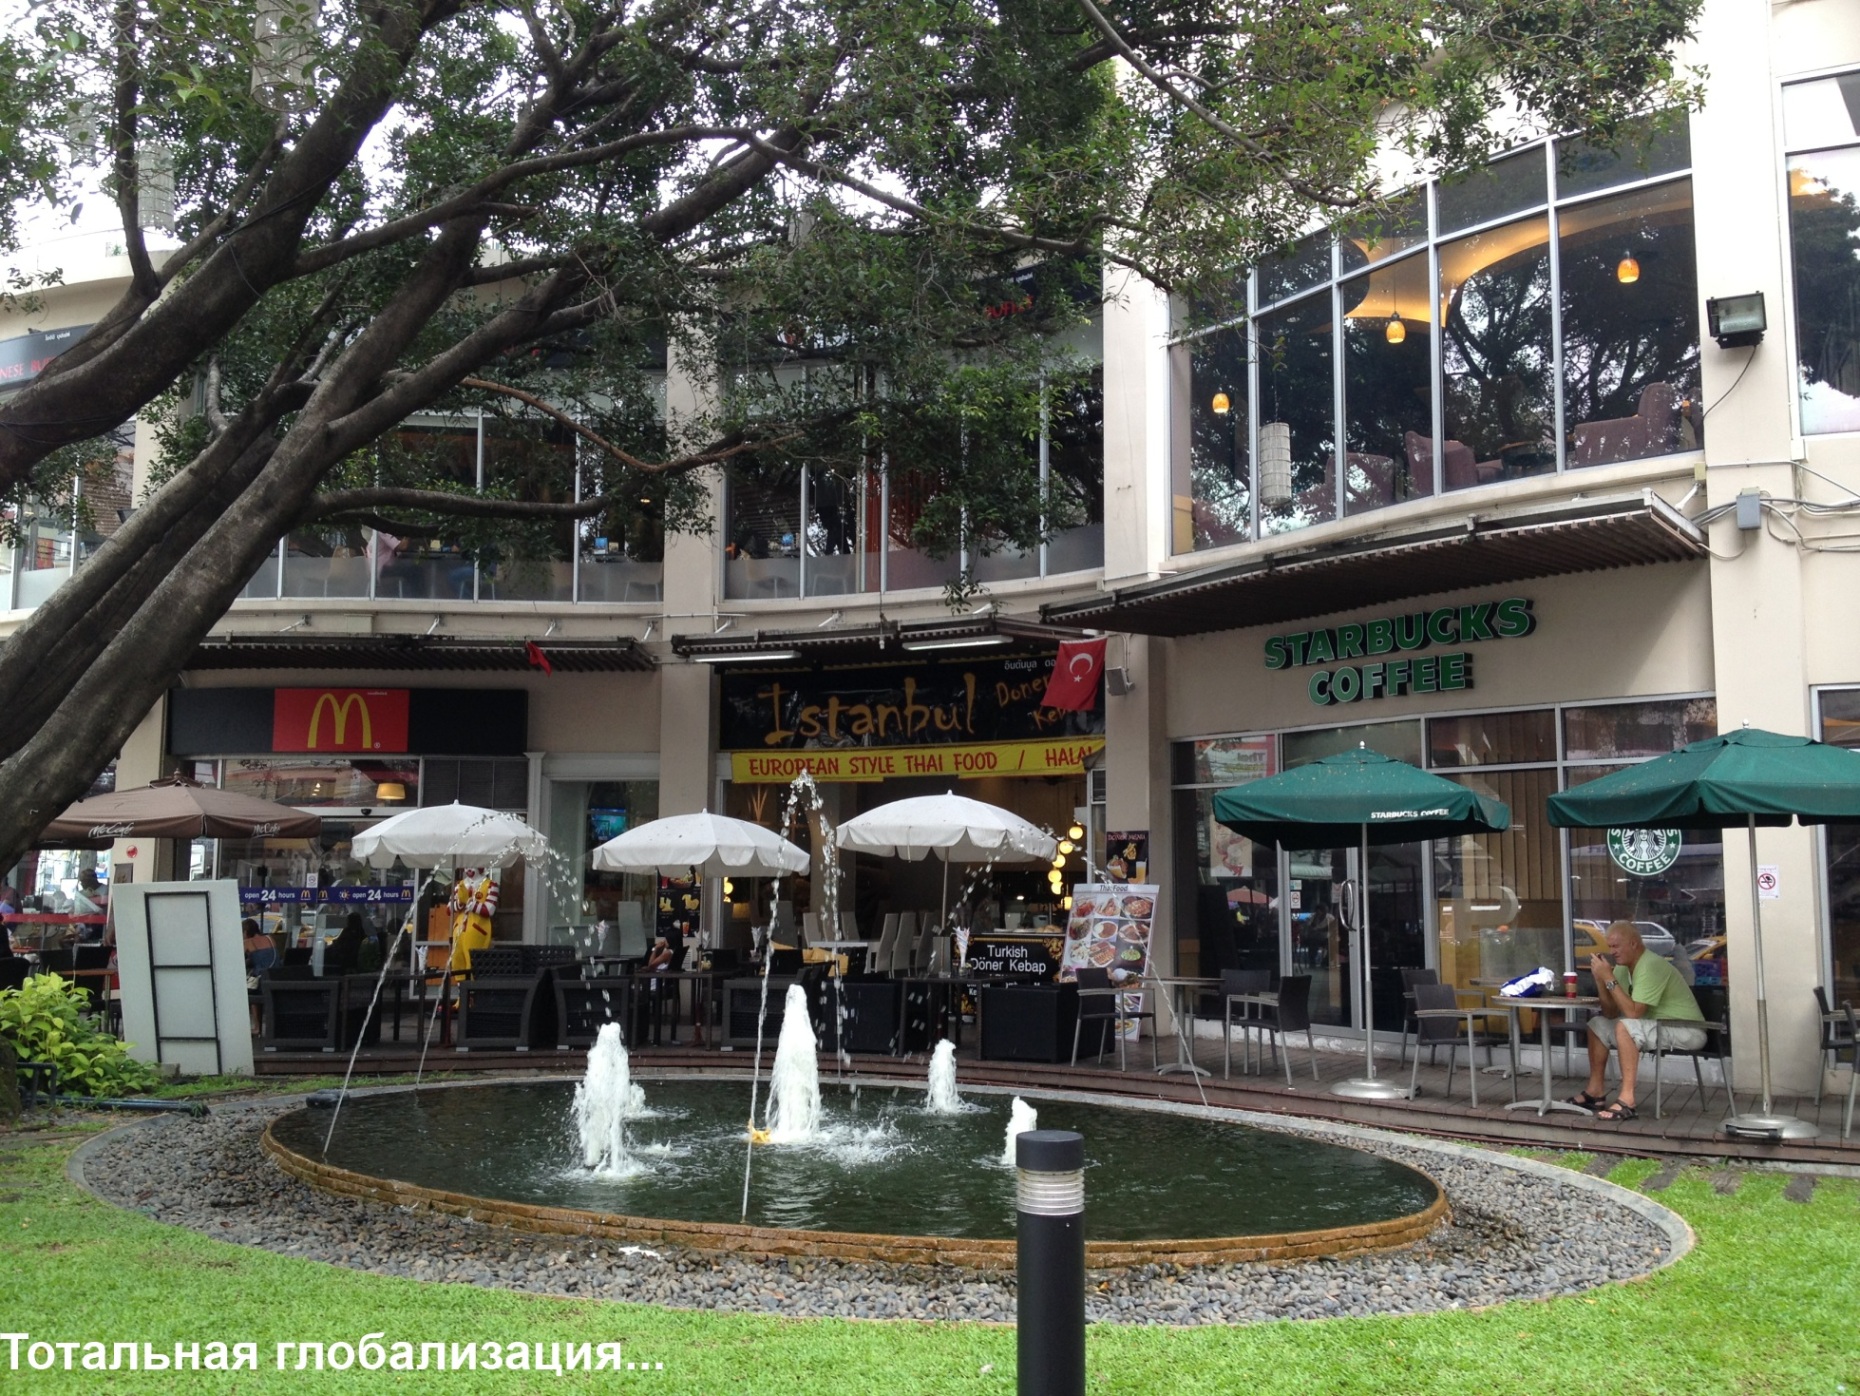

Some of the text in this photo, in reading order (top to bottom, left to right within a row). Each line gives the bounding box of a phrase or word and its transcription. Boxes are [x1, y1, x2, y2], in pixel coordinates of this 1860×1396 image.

[1264, 598, 1534, 670] STARBUCKS
[1308, 652, 1471, 705] COFFEE
[758, 672, 976, 745] Istanbul
[749, 757, 839, 776] EUROPEAN
[849, 756, 895, 774] STYLE
[904, 754, 943, 773] THAI
[953, 751, 998, 771] FOOD
[1371, 810, 1418, 819] STARBUCKS
[1618, 852, 1671, 873] COFFEE
[261, 889, 276, 901] 24
[278, 891, 296, 899] hours
[352, 891, 366, 899] open
[367, 889, 382, 901] 24
[1113, 884, 1129, 892] Food
[987, 944, 1028, 958] Turkish
[970, 956, 1047, 975] Döner Kebap
